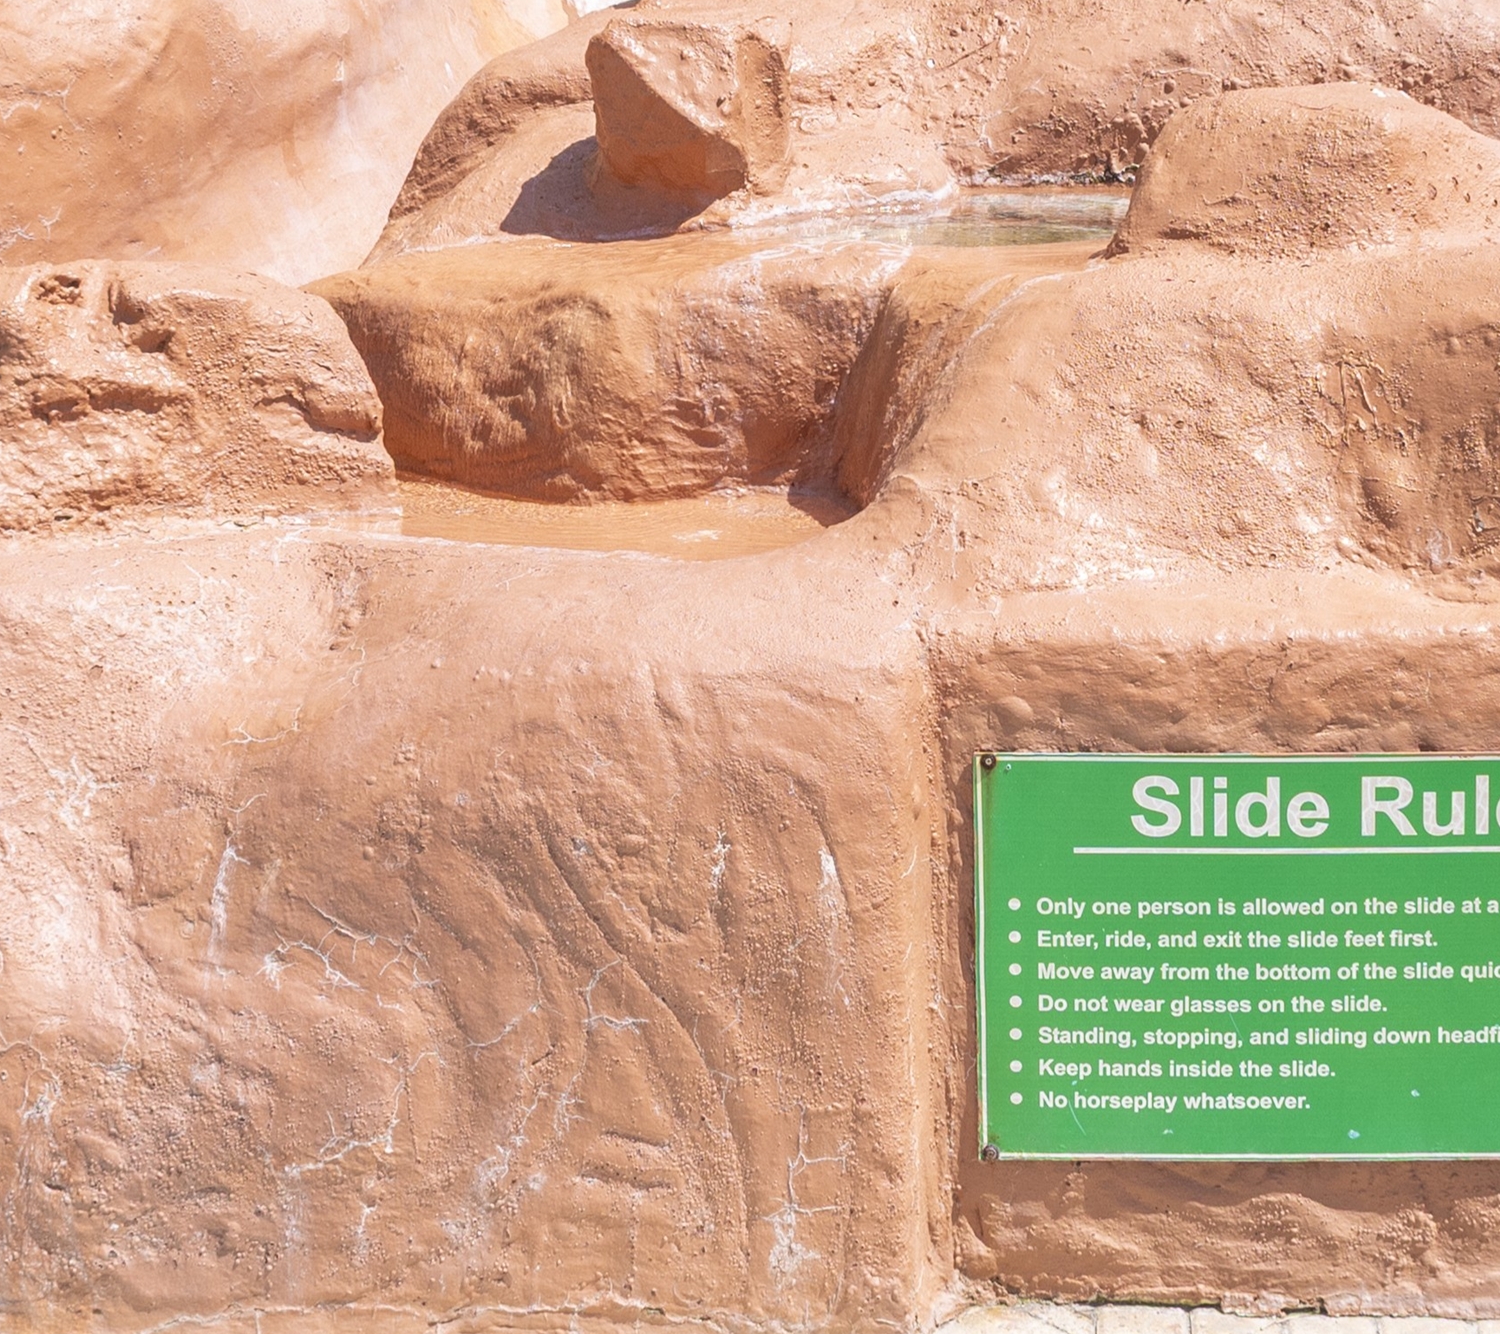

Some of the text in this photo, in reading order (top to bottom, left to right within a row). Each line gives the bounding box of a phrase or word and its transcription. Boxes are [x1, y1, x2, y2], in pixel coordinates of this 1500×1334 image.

[1130, 774, 1330, 838] Slide
[1036, 896, 1086, 920] Only
[1091, 901, 1132, 916] one
[1137, 901, 1212, 919] person
[1217, 897, 1237, 916] is
[1242, 897, 1325, 916] allowed
[1330, 901, 1358, 915] on
[1363, 897, 1398, 915] the
[1403, 896, 1456, 915] slide
[1461, 896, 1482, 914] at
[1486, 899, 1500, 914] a
[1037, 928, 1438, 951] Enter, ride, and exit the slide feet first.
[1037, 962, 1095, 980] Move
[1100, 966, 1155, 985] away
[1159, 962, 1210, 981] from
[1215, 962, 1250, 981] the
[1255, 962, 1331, 981] bottom
[1336, 962, 1360, 980] of
[1363, 962, 1398, 980] the
[1403, 961, 1455, 980] slide
[1038, 994, 1388, 1018] Do not wear glasses on the slide.
[1038, 1025, 1137, 1049] Standing,
[1143, 1027, 1243, 1050] stopping,
[1249, 1027, 1289, 1046] and
[1295, 1027, 1367, 1049] sliding
[1372, 1026, 1431, 1045] down
[1038, 1058, 1336, 1082] Keep hands inside the slide.
[1038, 1090, 1311, 1114] No horseplay whatsoever.
